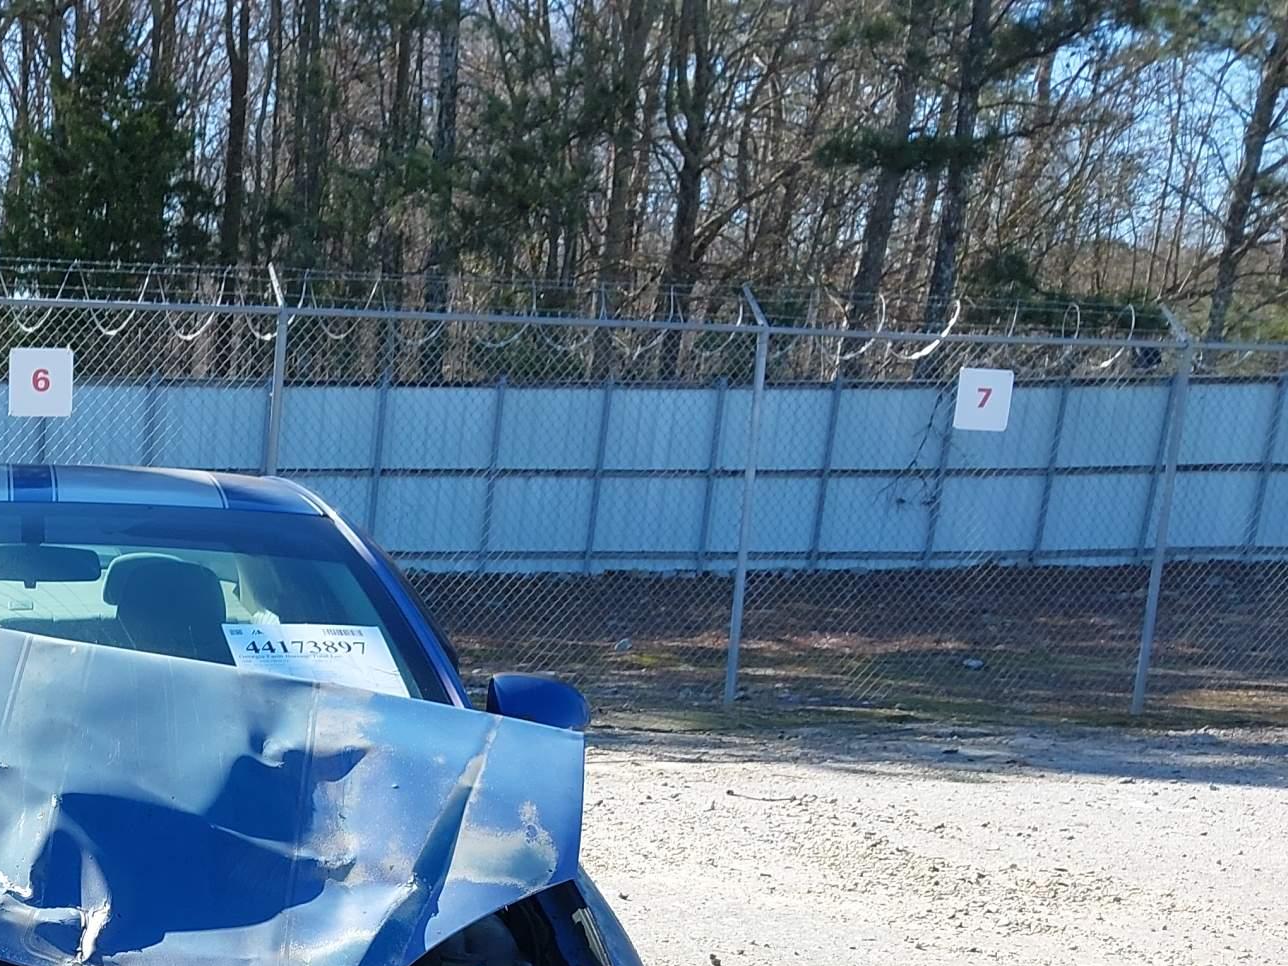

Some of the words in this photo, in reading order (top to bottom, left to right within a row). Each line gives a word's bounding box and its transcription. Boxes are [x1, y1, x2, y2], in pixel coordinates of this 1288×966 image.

[32, 368, 50, 392] 6
[977, 387, 993, 409] 7
[245, 640, 366, 655] 44173897
